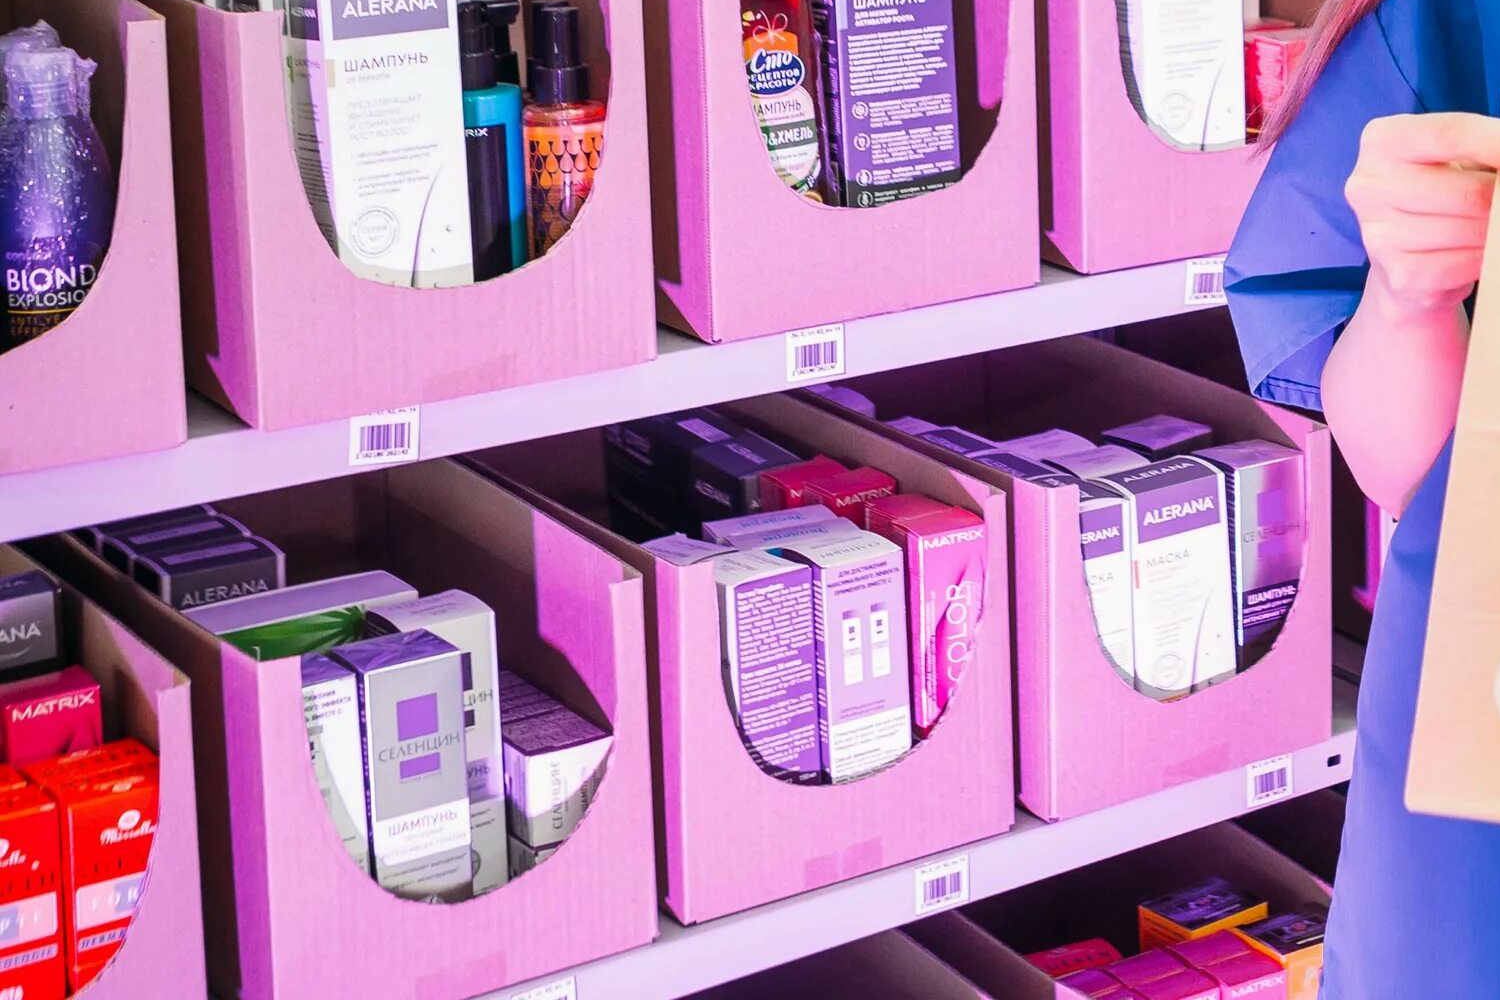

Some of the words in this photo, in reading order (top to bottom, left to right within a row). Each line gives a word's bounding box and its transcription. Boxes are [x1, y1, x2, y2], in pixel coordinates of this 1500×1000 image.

[344, 52, 428, 73] ШАМПУНЬ
[753, 98, 802, 117] АМПУНЬ
[8, 289, 89, 307] EXPLOSIO
[1123, 461, 1195, 483] ALERANA
[836, 486, 893, 508] MATRIX
[1143, 497, 1214, 526] ALERANA
[924, 528, 985, 550] MATRIX
[1146, 549, 1190, 568] МАСКА
[181, 579, 269, 606] ALERANA
[946, 579, 968, 697] COLOR
[12, 690, 95, 723] MATRIX
[378, 732, 460, 763] СЕЛЕНЦИН
[388, 810, 458, 838] ШАМПУНЬ
[1231, 975, 1285, 998] MATRIX
